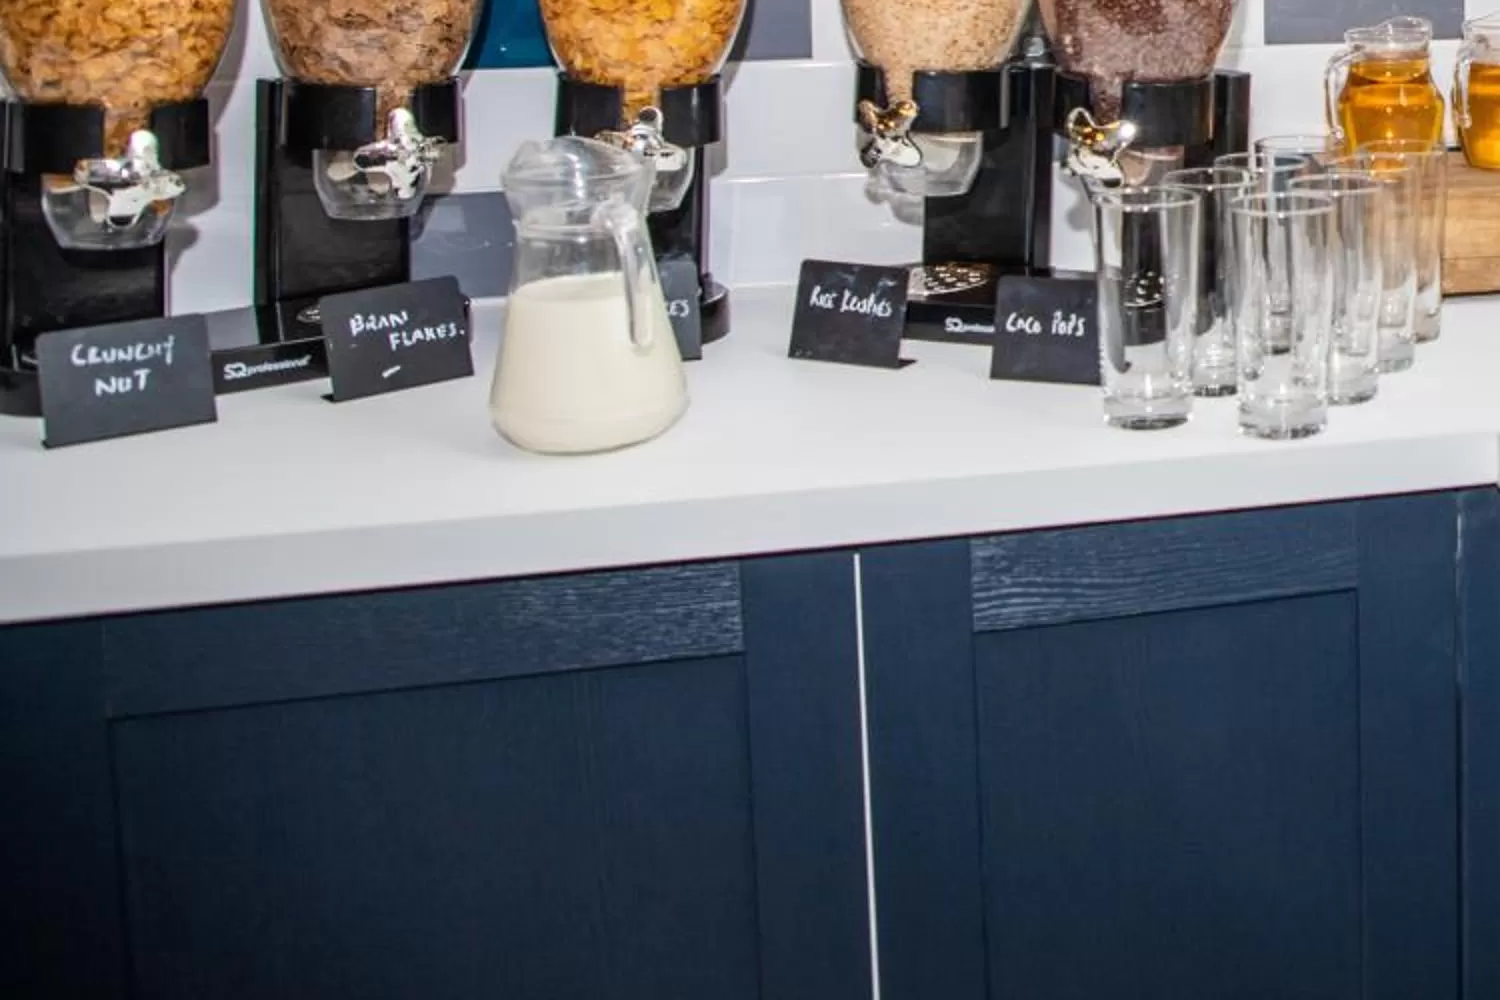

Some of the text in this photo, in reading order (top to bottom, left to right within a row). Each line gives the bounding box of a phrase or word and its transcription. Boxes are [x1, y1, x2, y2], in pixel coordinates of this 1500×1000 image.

[350, 310, 409, 337] BRAN
[71, 333, 175, 367] CRUNCHY
[94, 367, 152, 397] NUT
